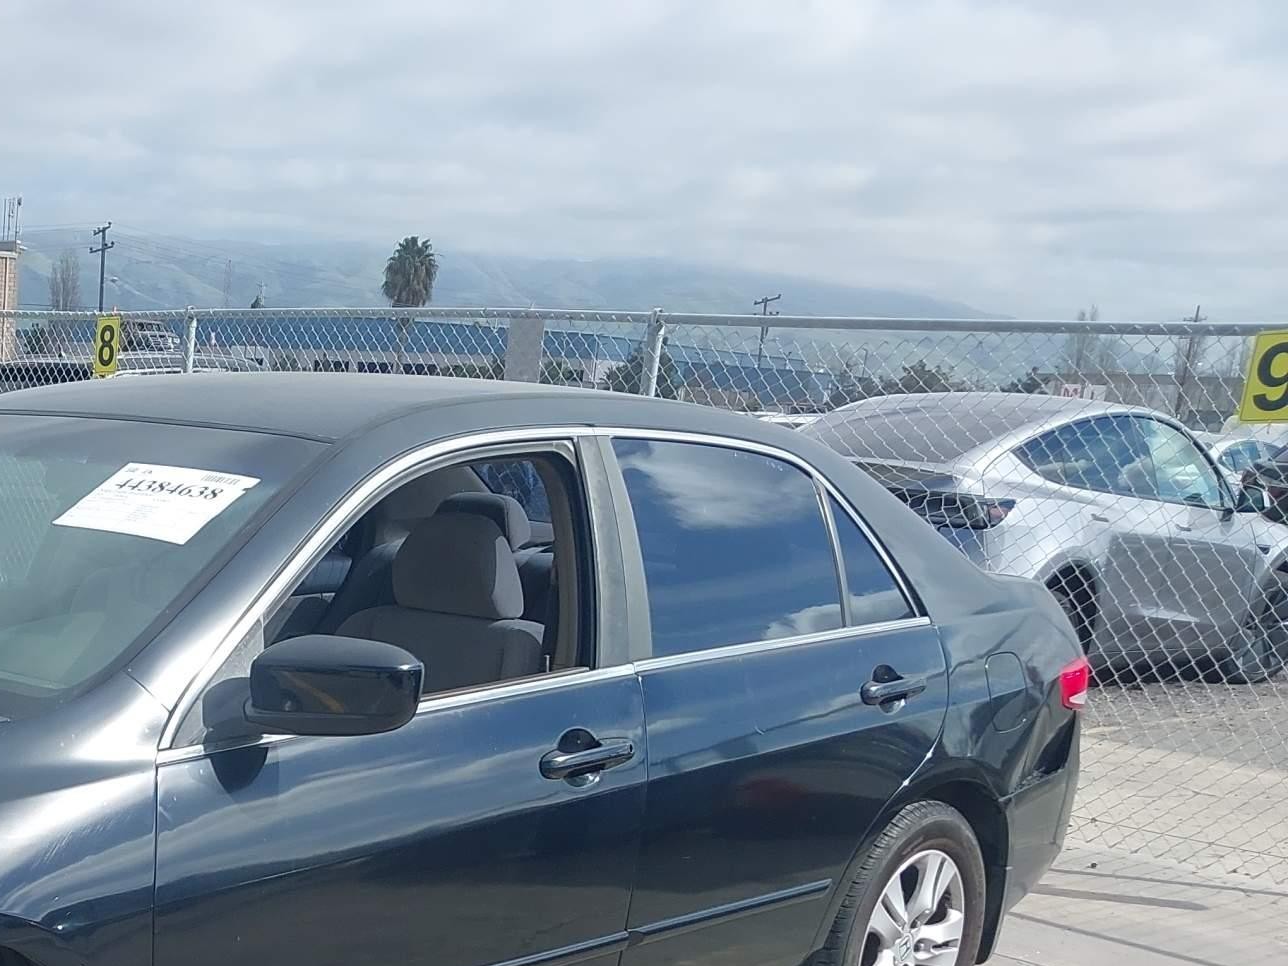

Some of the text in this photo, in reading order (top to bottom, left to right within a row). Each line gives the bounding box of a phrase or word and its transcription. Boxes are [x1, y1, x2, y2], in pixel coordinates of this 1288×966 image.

[98, 324, 115, 367] 8
[1252, 341, 1288, 411] 9
[114, 477, 224, 501] 44384638
